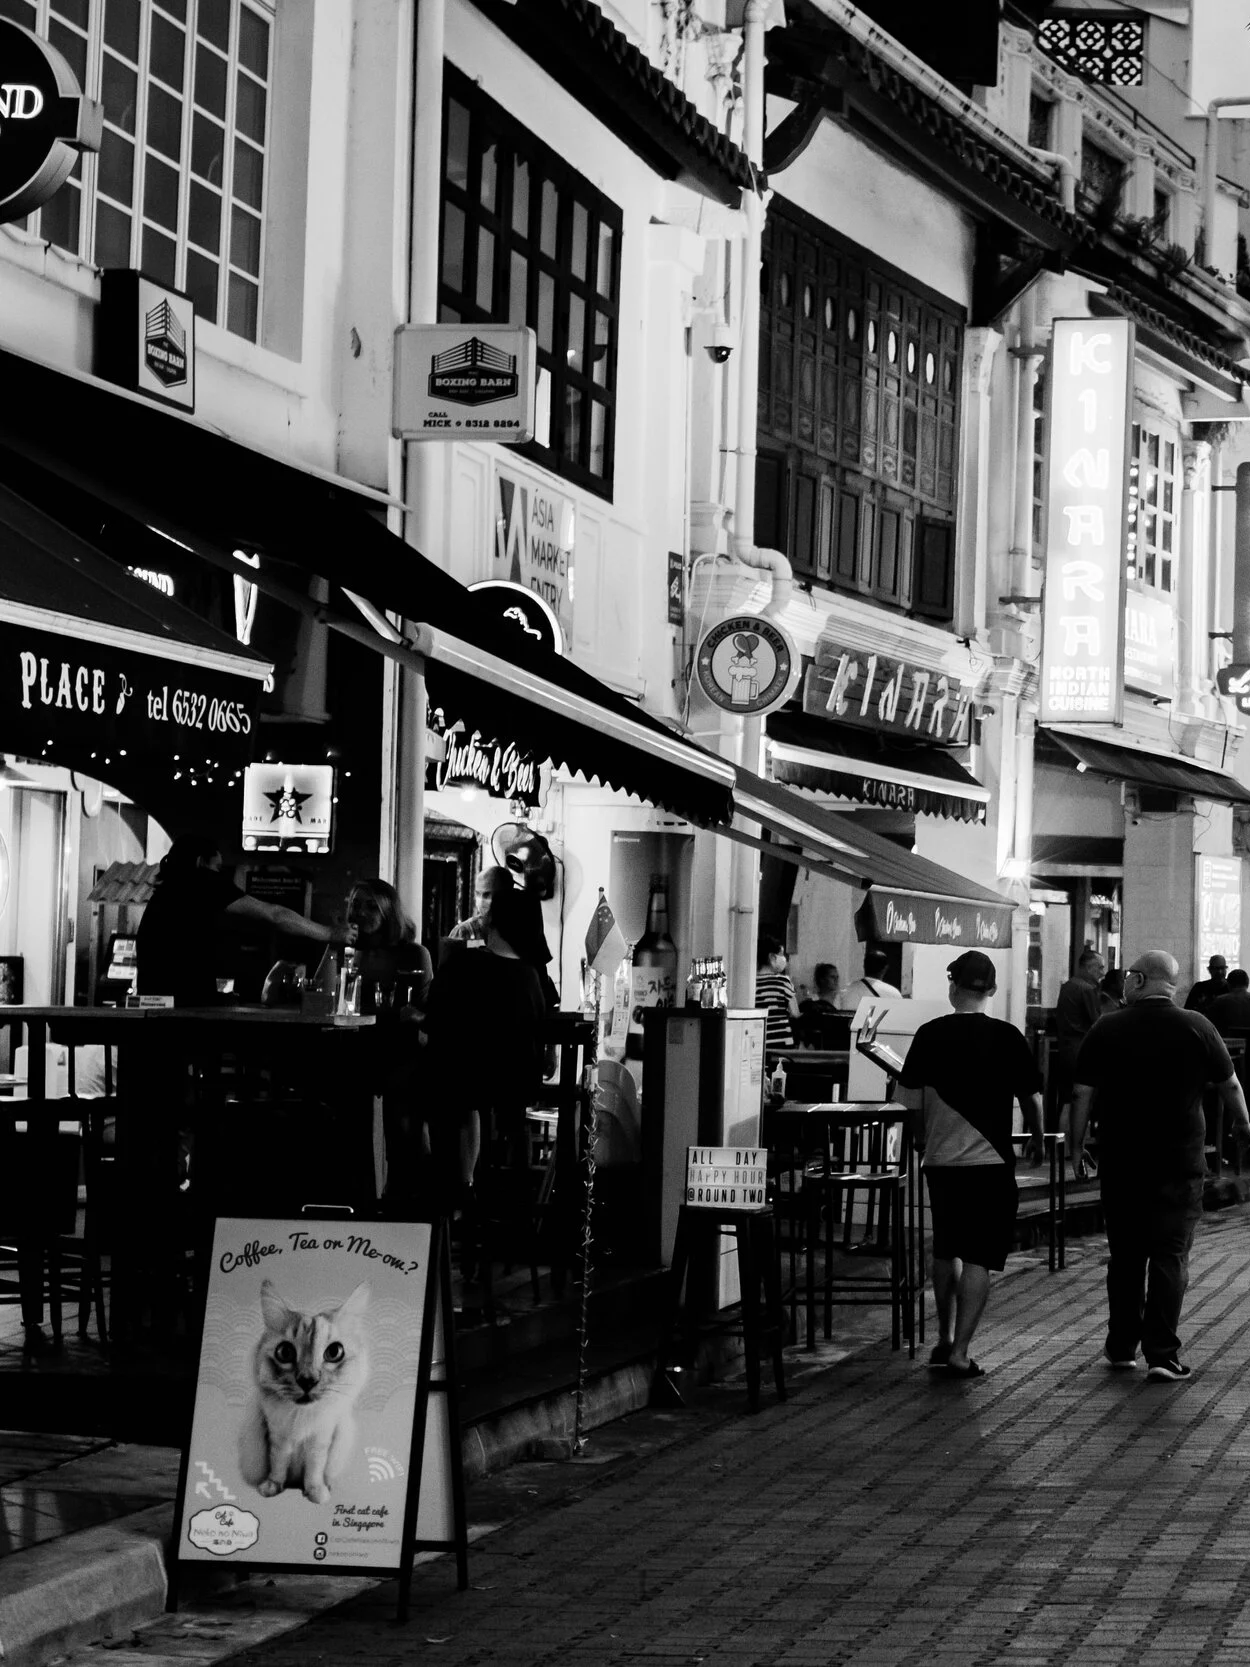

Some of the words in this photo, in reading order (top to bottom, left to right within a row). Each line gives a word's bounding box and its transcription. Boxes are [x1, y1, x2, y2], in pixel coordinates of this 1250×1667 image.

[435, 378, 477, 387] BOXING
[480, 378, 512, 387] BARN
[423, 419, 452, 428] MICK
[1058, 331, 1113, 657] KINARA
[532, 496, 554, 533] ASIA
[531, 535, 571, 578] MARKET
[706, 620, 750, 648] CHICKEN
[752, 622, 761, 631] &
[762, 627, 785, 653] BEER
[1049, 665, 1110, 681] NORTH
[19, 651, 105, 715] PLACE
[147, 685, 169, 721] tel
[172, 688, 207, 730] 6532
[207, 697, 251, 735] 0665
[1049, 680, 1110, 697] INDIAN
[826, 653, 970, 742] KINARA
[1048, 696, 1110, 711] CUISINE
[862, 779, 915, 807] KINARA
[692, 1150, 713, 1165] ALL
[735, 1151, 758, 1166] DAY
[689, 1169, 727, 1184] HAPPY
[734, 1170, 763, 1185] HOUR
[687, 1187, 736, 1203] @ROUND
[743, 1189, 763, 1204] TWO
[219, 1240, 283, 1274] Coffee,
[288, 1232, 319, 1251] Tea
[323, 1239, 344, 1250] or
[333, 1504, 356, 1515] First
[357, 1505, 371, 1516] cat
[371, 1505, 390, 1519] cafe
[332, 1518, 341, 1527] in
[342, 1517, 385, 1532] Singapore
